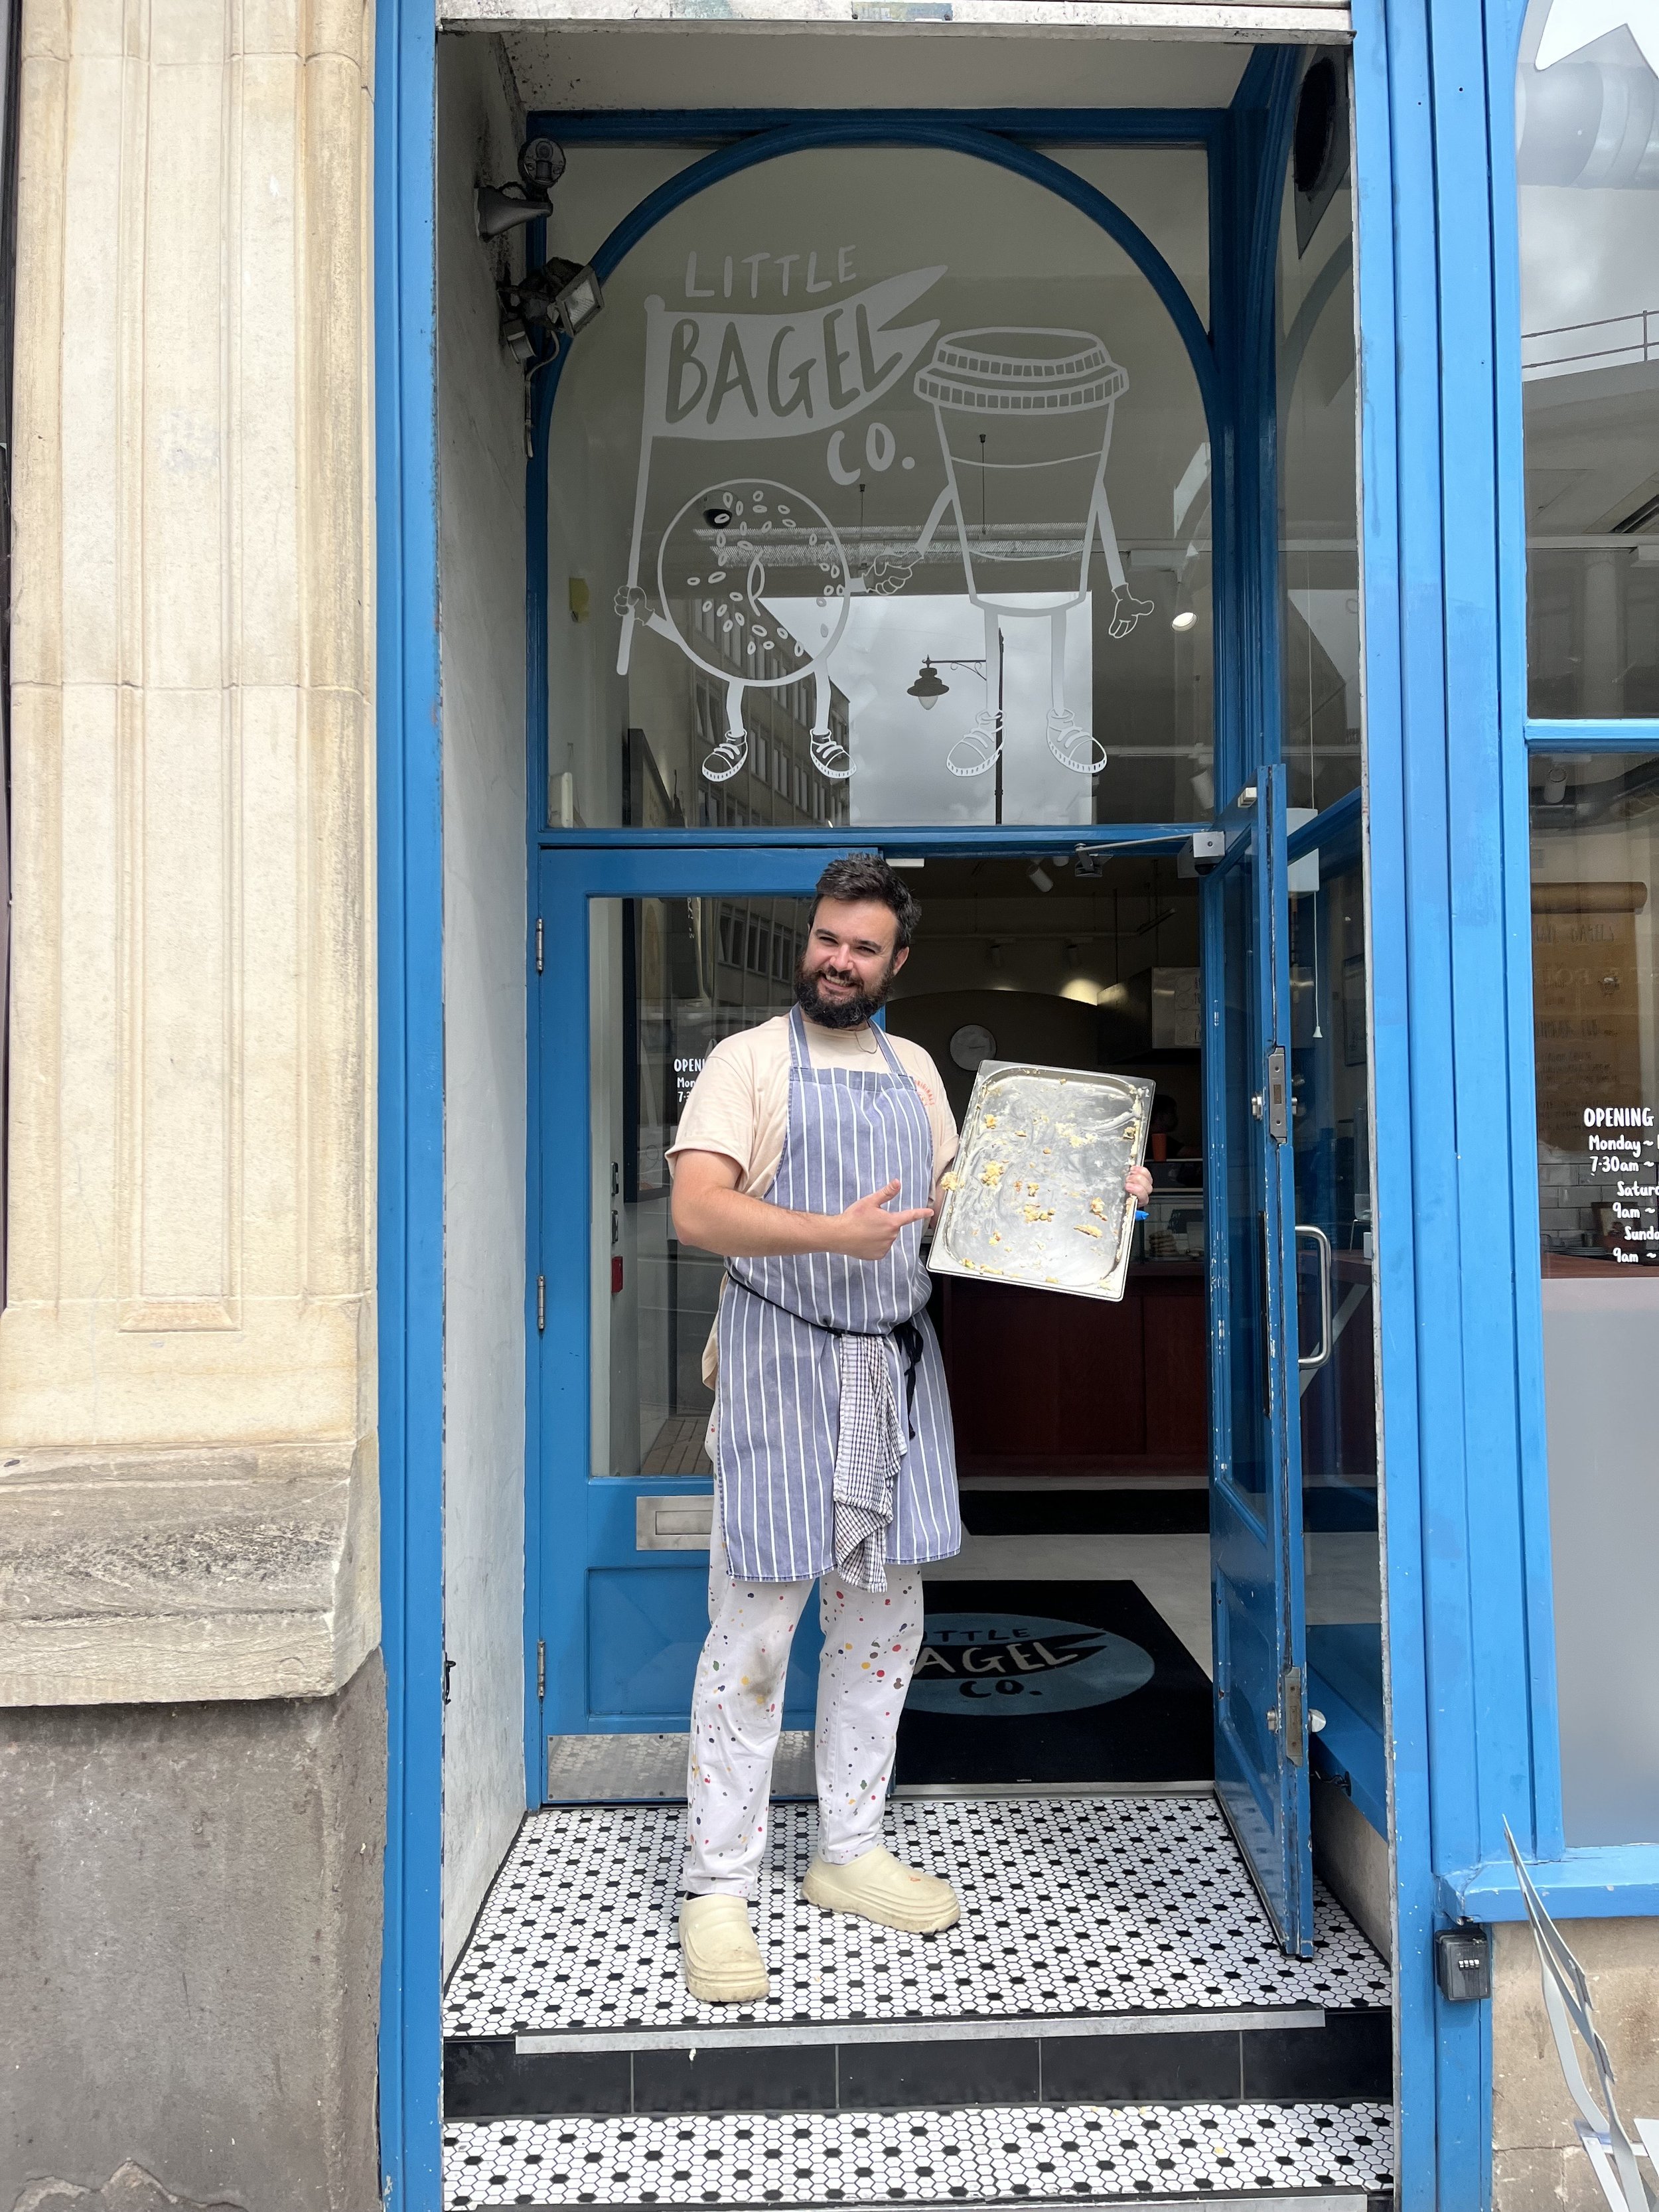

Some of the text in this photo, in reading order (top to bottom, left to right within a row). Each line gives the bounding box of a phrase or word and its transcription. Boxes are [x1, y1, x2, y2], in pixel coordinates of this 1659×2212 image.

[685, 245, 857, 298] LITTLE
[665, 304, 902, 425] BAGEL
[827, 422, 915, 486] CO.
[674, 1058, 705, 1072] OPENI
[677, 1076, 695, 1089] Mon
[1583, 1107, 1655, 1128] OPENING
[1589, 1134, 1641, 1158] Monday
[1613, 1202, 1640, 1218] 9am
[1613, 1247, 1639, 1263] 9am
[913, 1642, 1078, 1675] AGEL
[960, 1680, 1043, 1698] CO.
